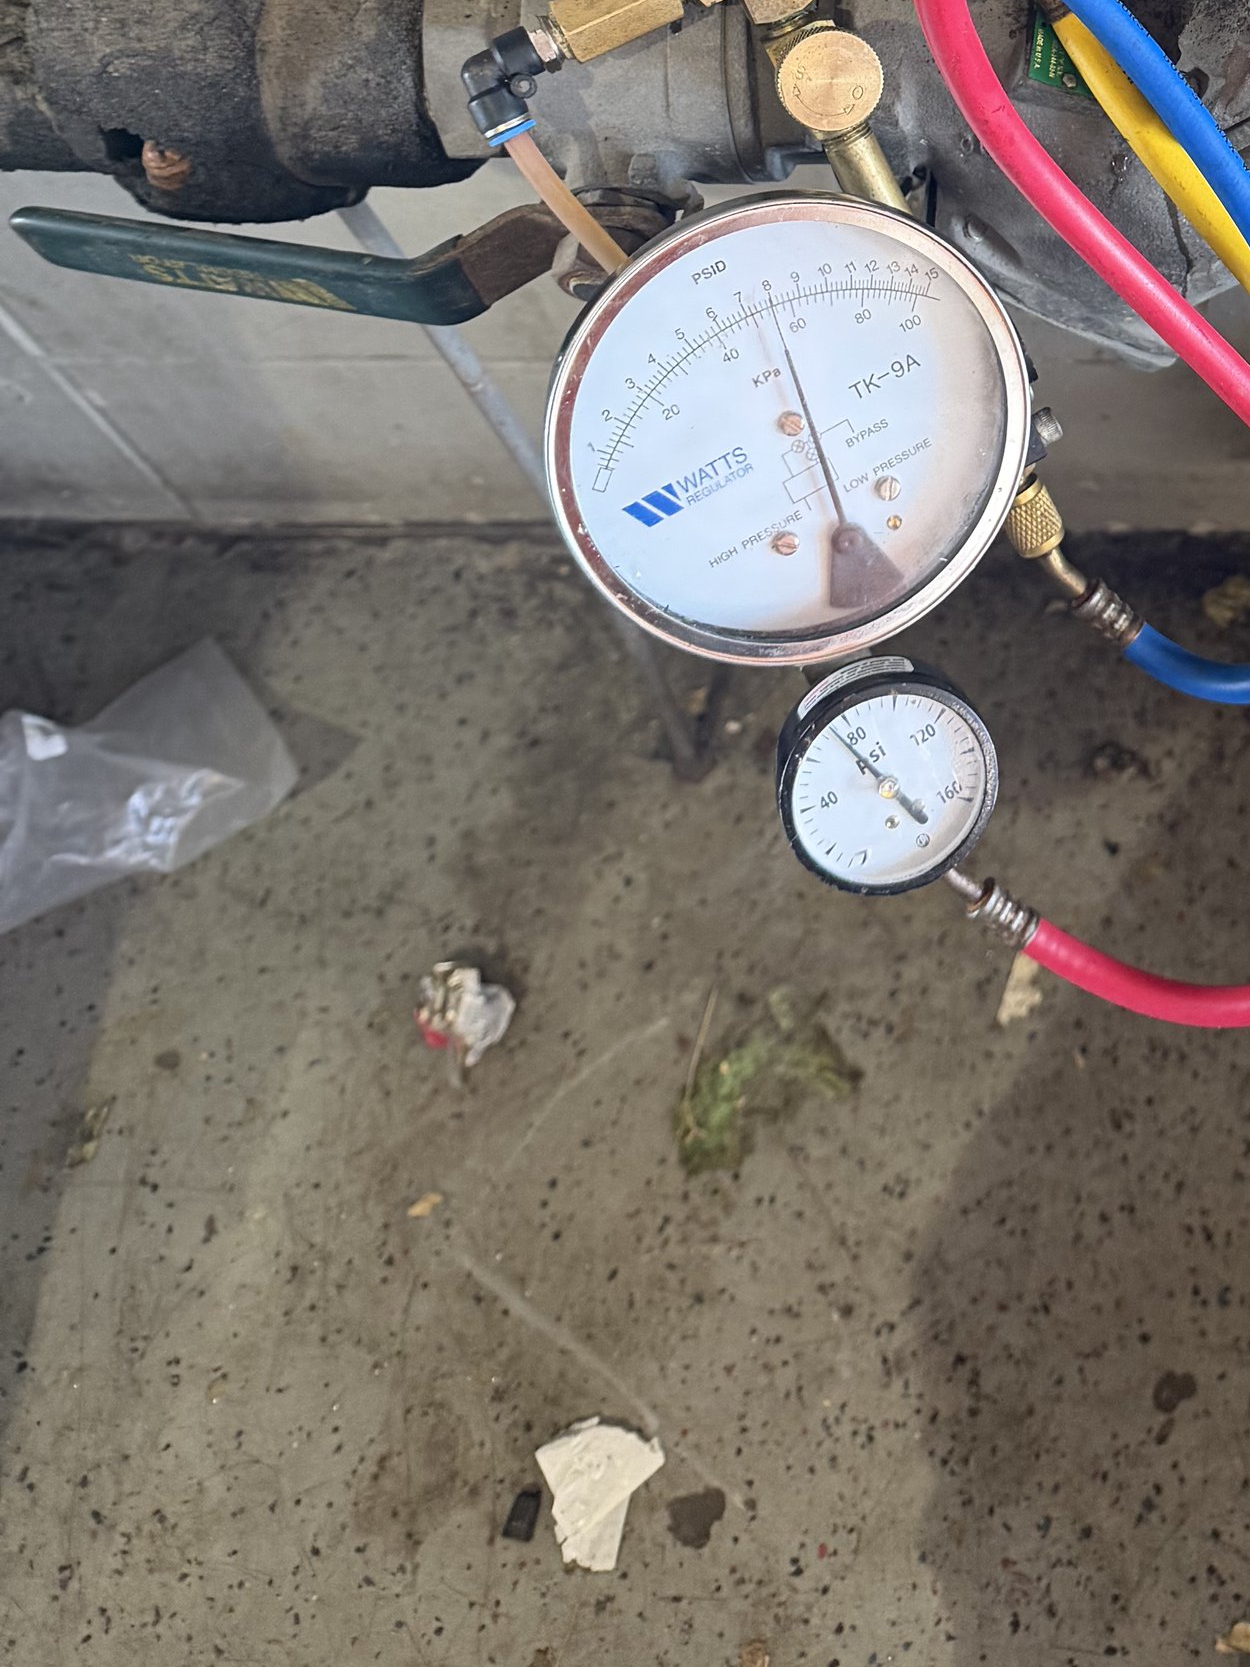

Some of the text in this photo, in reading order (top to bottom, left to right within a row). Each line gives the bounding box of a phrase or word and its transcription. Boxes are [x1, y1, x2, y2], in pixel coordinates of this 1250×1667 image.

[691, 259, 728, 287] PSID
[817, 262, 834, 278] 10
[844, 259, 859, 275] 11
[865, 259, 880, 274] 12
[885, 259, 902, 276] 13
[904, 262, 921, 279] 14
[924, 266, 941, 283] 15
[790, 270, 801, 284] 9
[761, 279, 773, 293] 8
[733, 290, 744, 305] 7
[705, 306, 717, 321] 6
[854, 308, 873, 326] 80
[788, 317, 807, 333] 60
[898, 314, 923, 333] 100
[674, 327, 686, 341] 5
[647, 352, 658, 366] 4
[721, 347, 741, 364] 40
[624, 376, 637, 391] 3
[751, 365, 783, 390] KPa
[848, 353, 922, 401] TK-9A
[601, 408, 614, 424] 2
[662, 403, 682, 421] 20
[844, 418, 890, 449] BYPASS
[676, 446, 750, 493] WATTS
[843, 437, 933, 494] LOW PRESSURE
[686, 463, 755, 507] REGULATOR
[708, 510, 804, 570] HIGH PRESSURE
[846, 726, 868, 746] 80
[909, 722, 937, 747] 120
[820, 790, 839, 809] 40
[936, 780, 964, 805] 160
